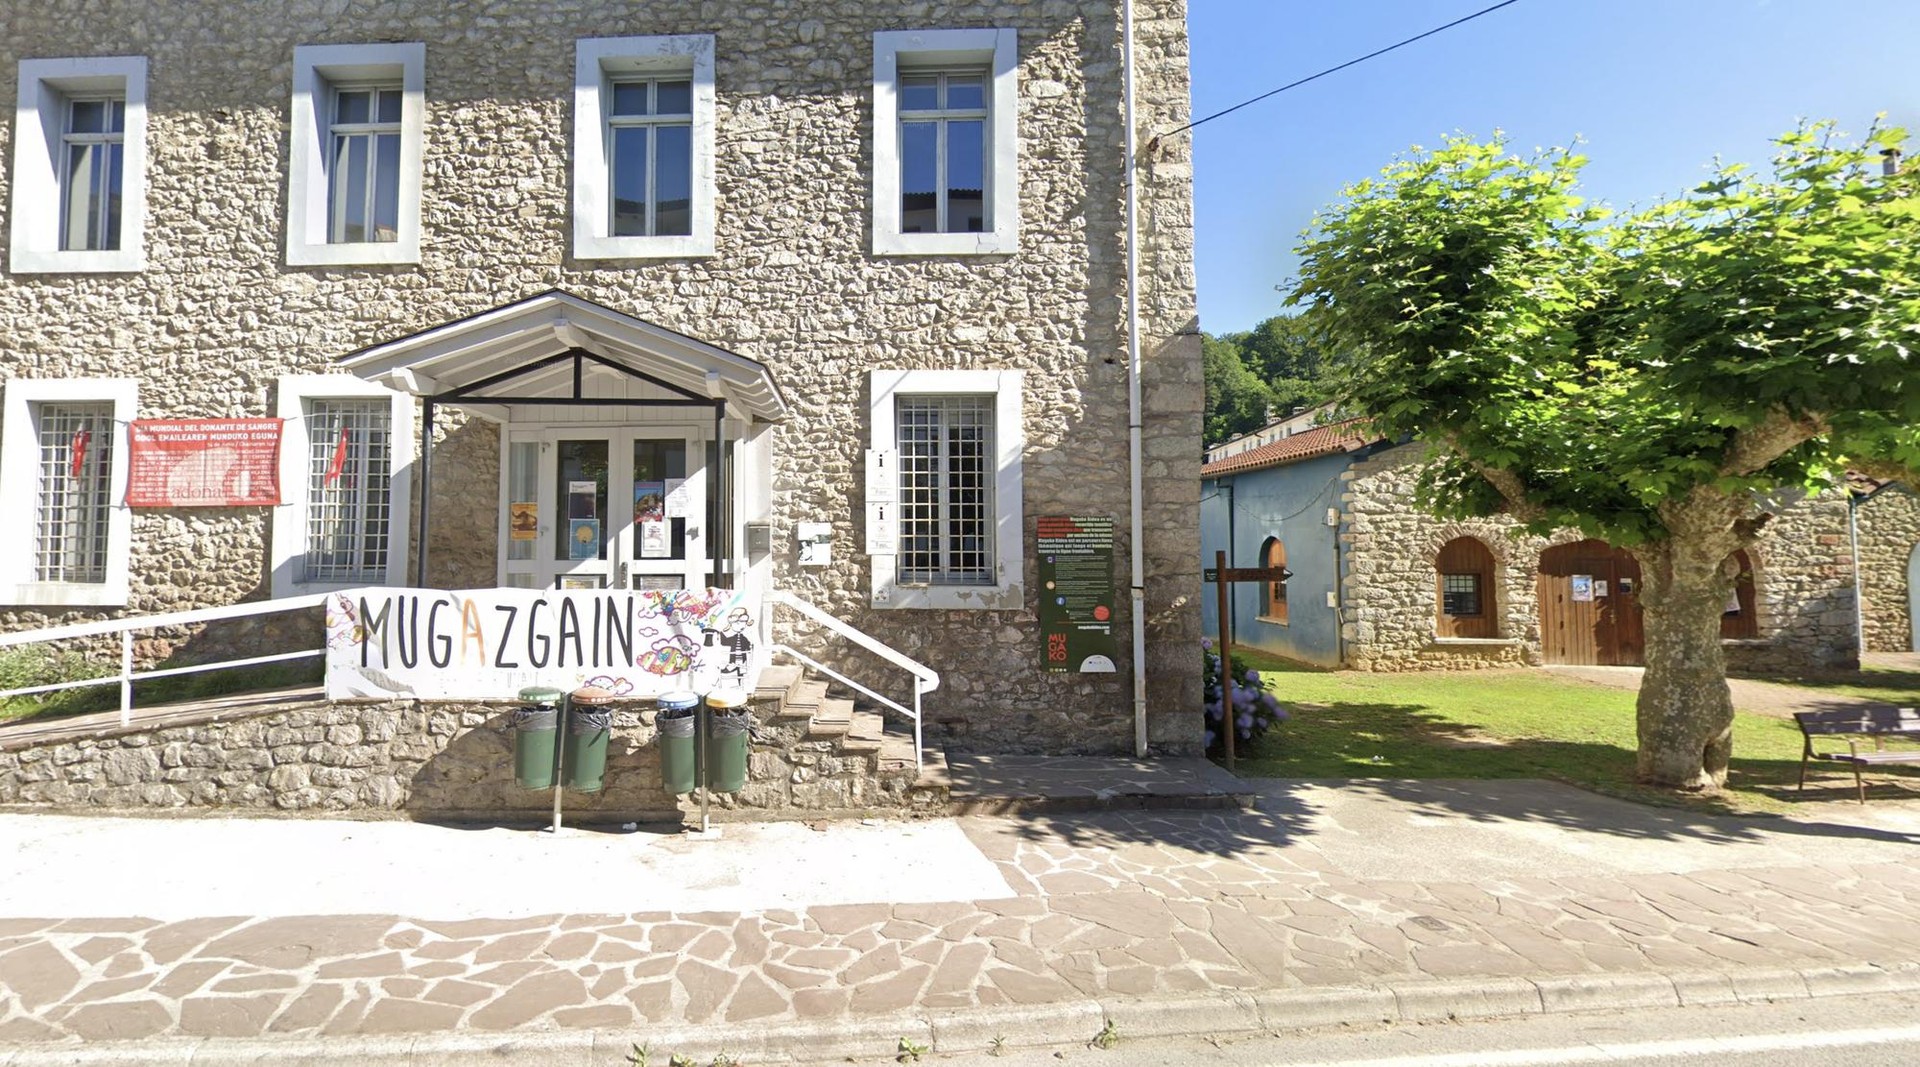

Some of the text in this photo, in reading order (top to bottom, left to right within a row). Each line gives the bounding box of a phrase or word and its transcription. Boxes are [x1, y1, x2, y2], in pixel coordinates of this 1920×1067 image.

[150, 424, 182, 432] MUNDIAL
[236, 423, 247, 431] DE
[135, 432, 278, 442] ODOL EMAILEAREN MUNDUKO EGUNA
[360, 595, 634, 669] MUGAZGAIN
[1048, 633, 1067, 643] MU
[1048, 642, 1066, 651] GA
[1048, 651, 1067, 661] KO
